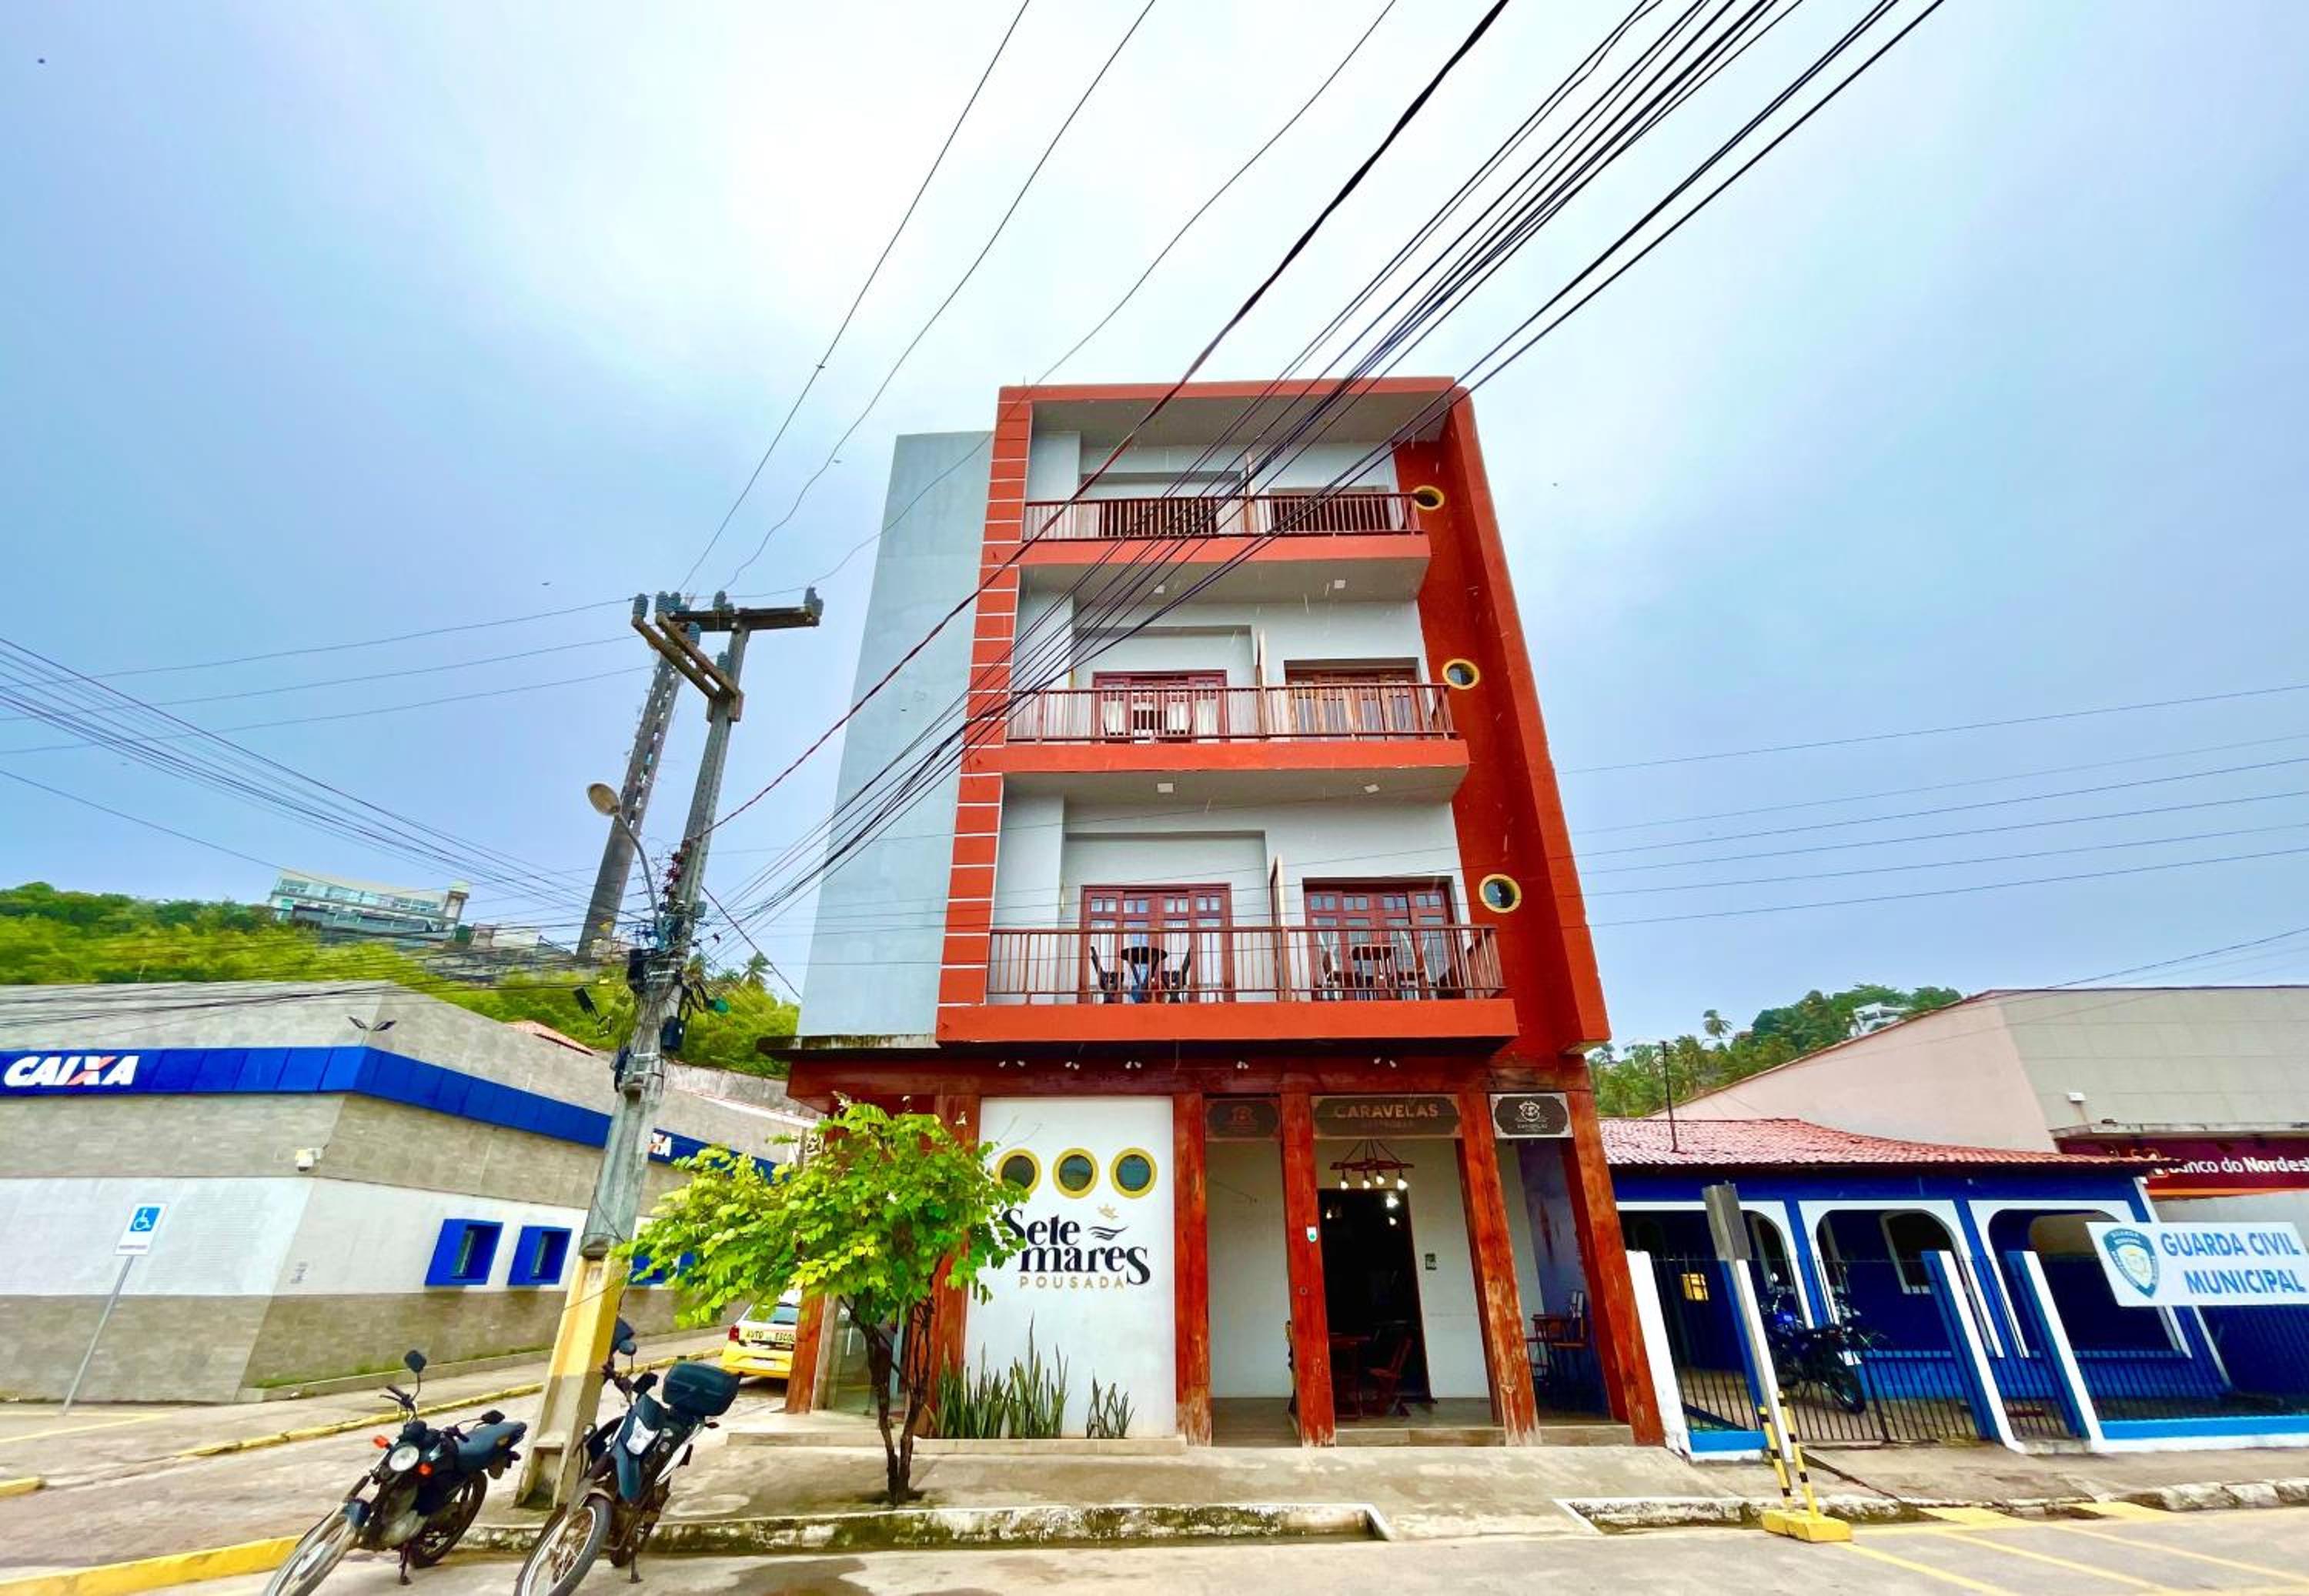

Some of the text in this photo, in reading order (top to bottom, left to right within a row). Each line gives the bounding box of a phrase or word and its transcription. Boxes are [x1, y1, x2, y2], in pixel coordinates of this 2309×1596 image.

[4, 1055, 139, 1087] CAIXA
[1335, 1104, 1439, 1118] CARAVELAS
[2167, 1160, 2219, 1174] nco
[2221, 1157, 2243, 1173] do
[1001, 1208, 1081, 1246] Sete
[2160, 1232, 2249, 1256] GUARDA
[2248, 1232, 2301, 1256] CIVIL
[1018, 1246, 1151, 1285] mares
[1019, 1276, 1125, 1289] POUSADA
[2184, 1269, 2307, 1294] MUNICIPAL
